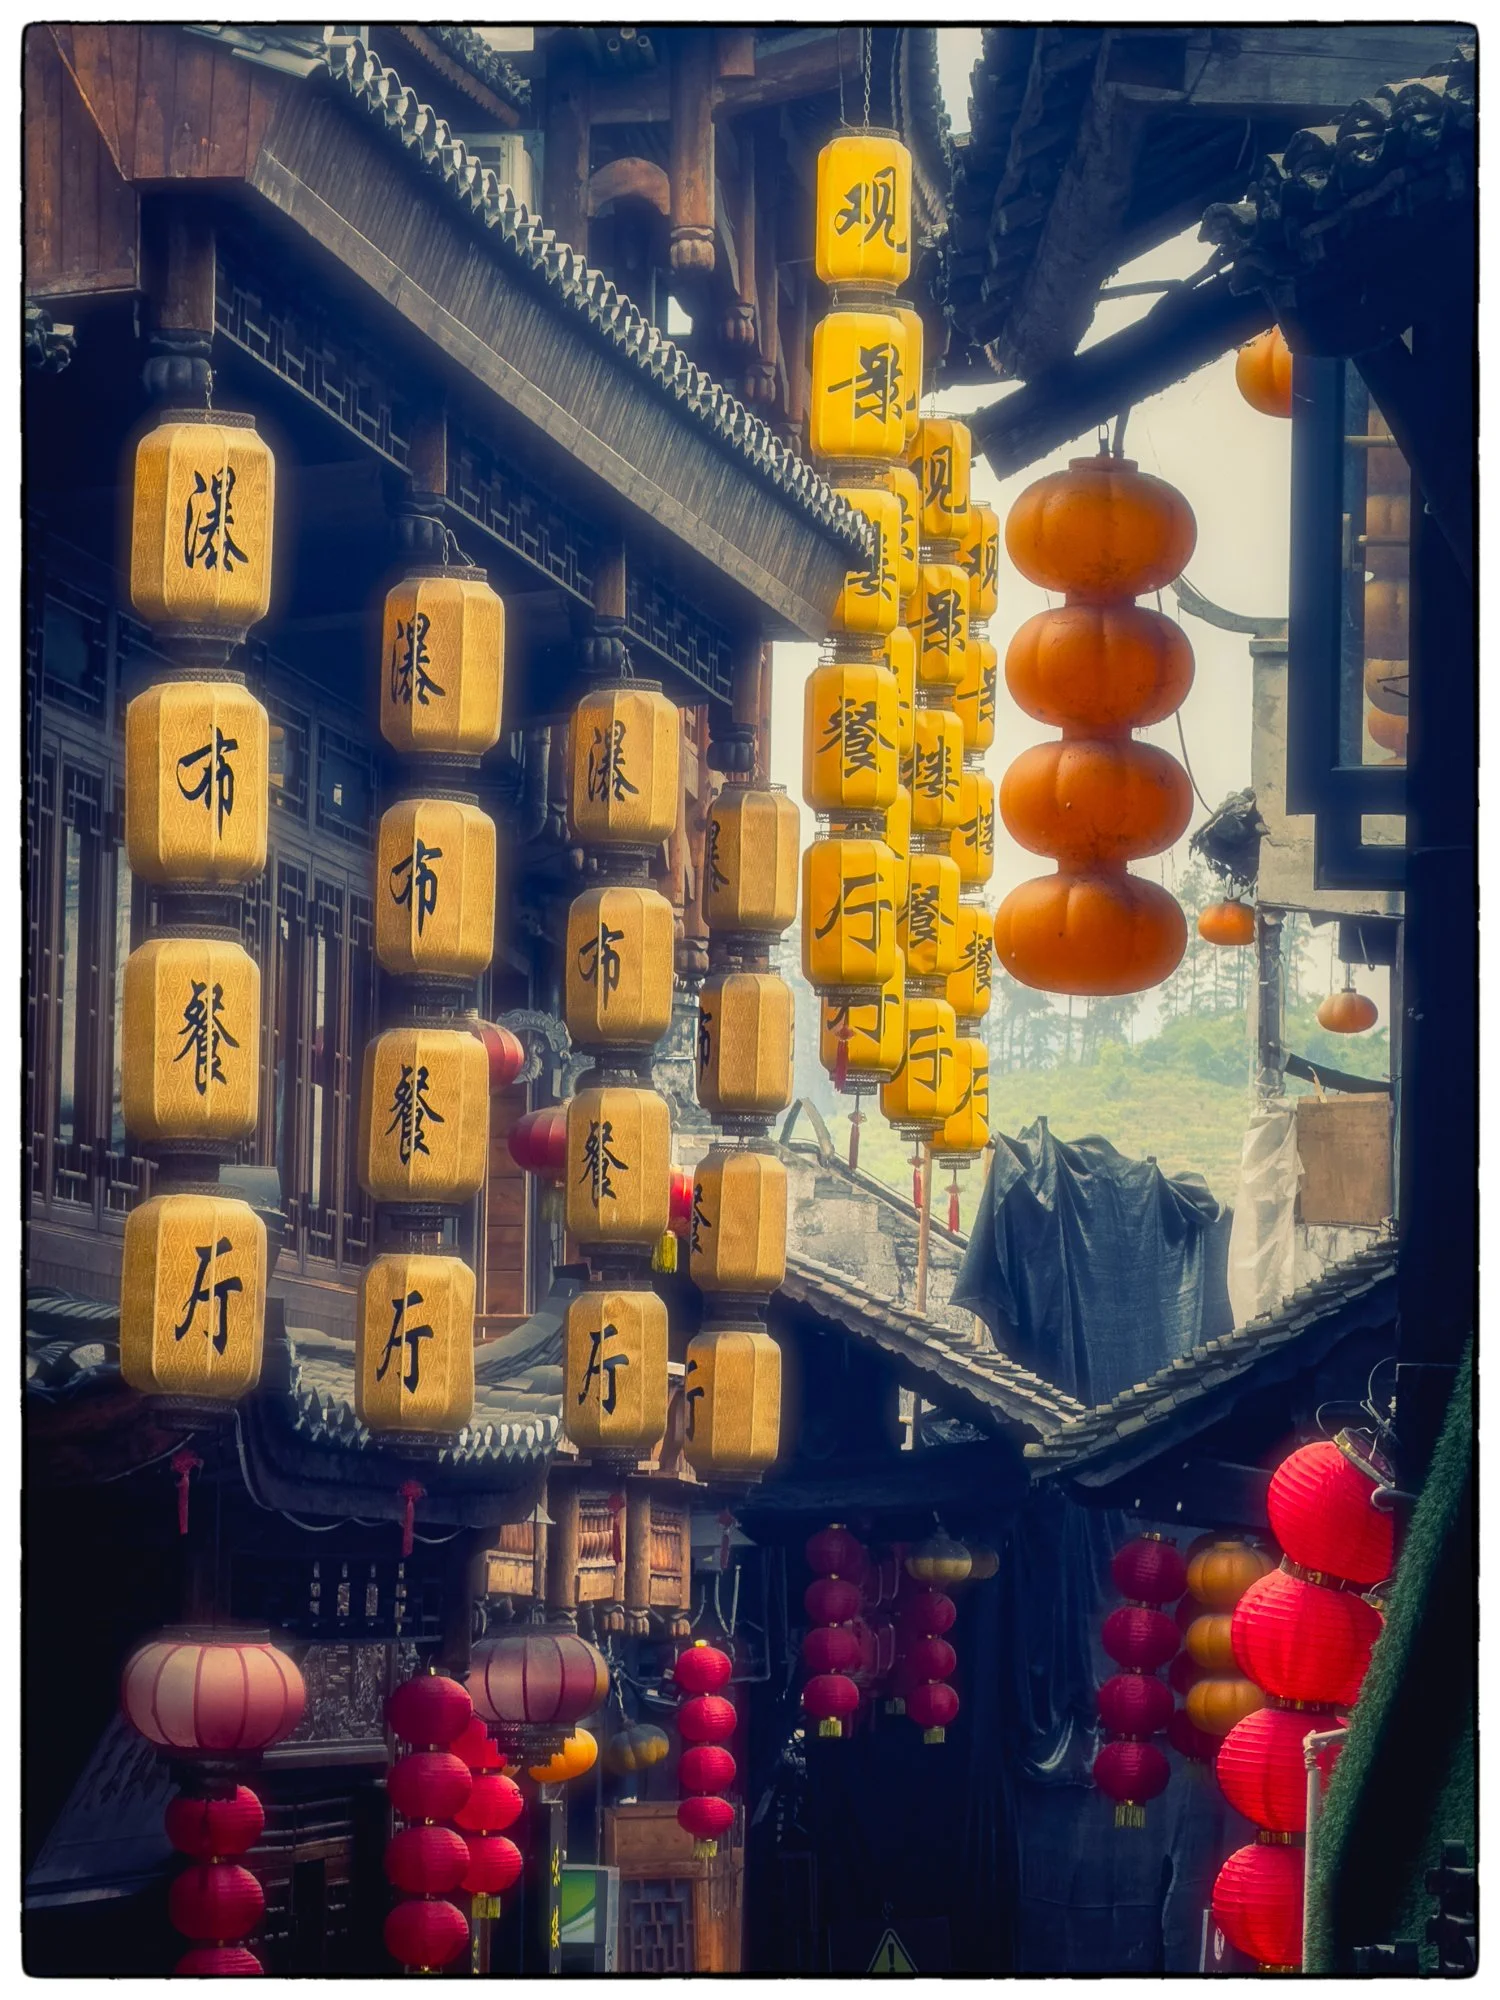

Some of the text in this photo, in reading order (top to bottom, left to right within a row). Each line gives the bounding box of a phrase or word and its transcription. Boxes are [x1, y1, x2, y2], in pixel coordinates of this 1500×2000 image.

[173, 466, 249, 1356] 瀑 布 餐 厅
[815, 166, 907, 954] 观 景 餐 厅
[889, 445, 967, 1092] 观 景 楼 餐 厅
[376, 612, 446, 1394] 瀑 布 餐 厅
[578, 719, 639, 1416] 瀑 布 餐 厅
